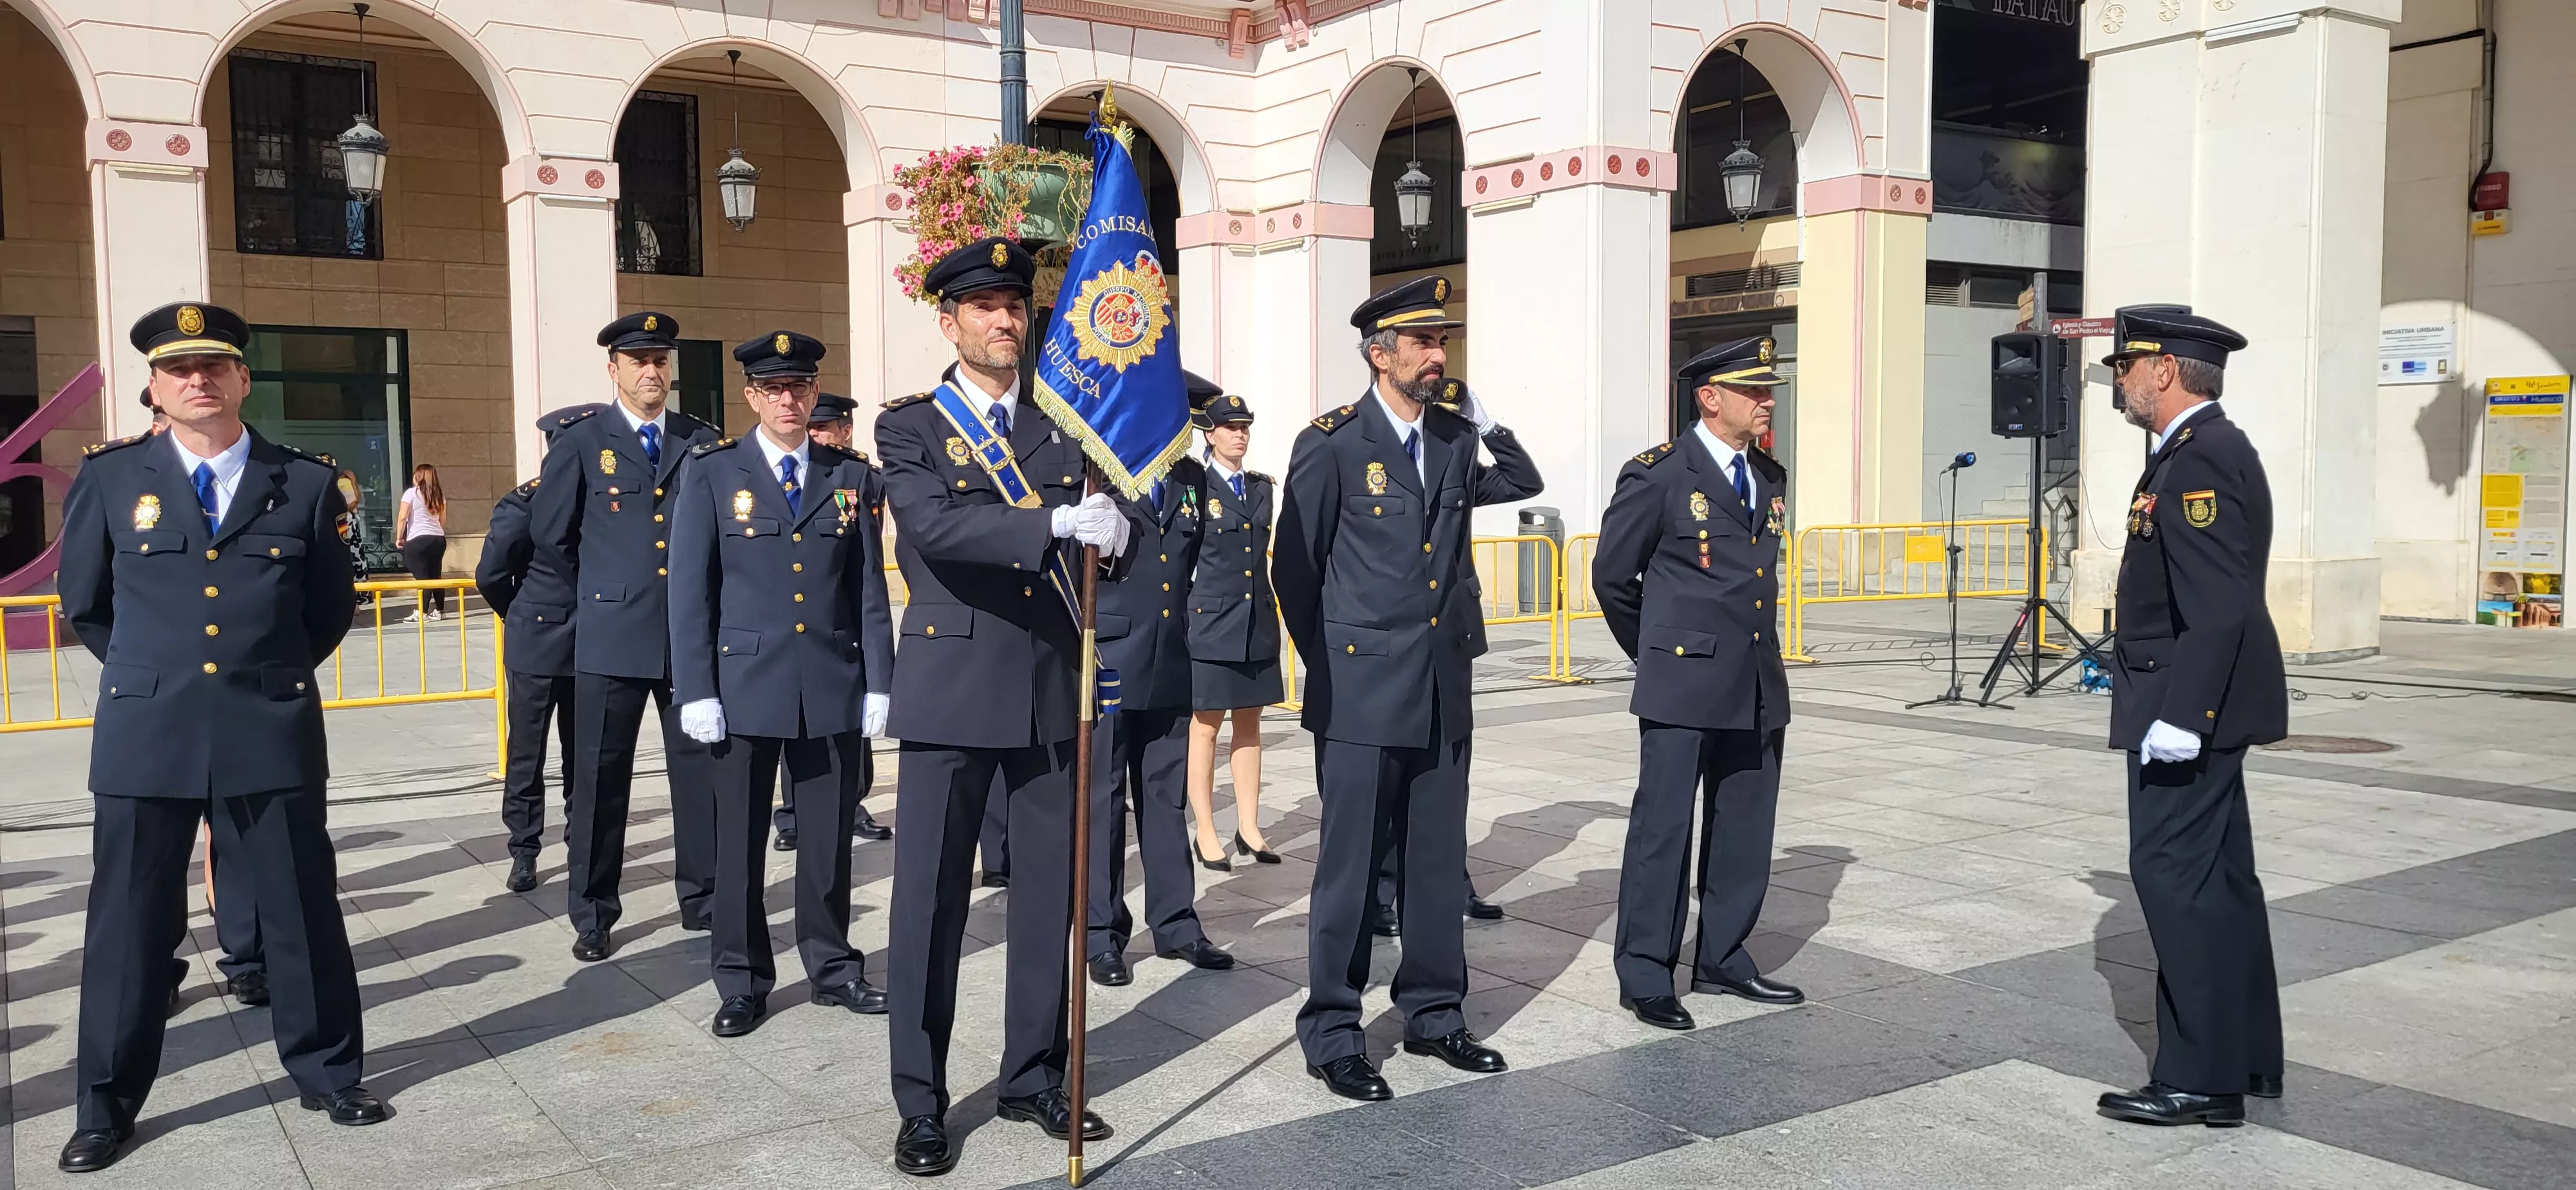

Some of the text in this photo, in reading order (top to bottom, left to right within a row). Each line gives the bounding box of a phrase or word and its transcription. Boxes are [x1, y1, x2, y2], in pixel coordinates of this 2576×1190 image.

[1077, 216, 1155, 249] COMISAR
[1103, 287, 1150, 335] CUERPO NACIONAL DE
[1045, 336, 1100, 398] HUESCA
